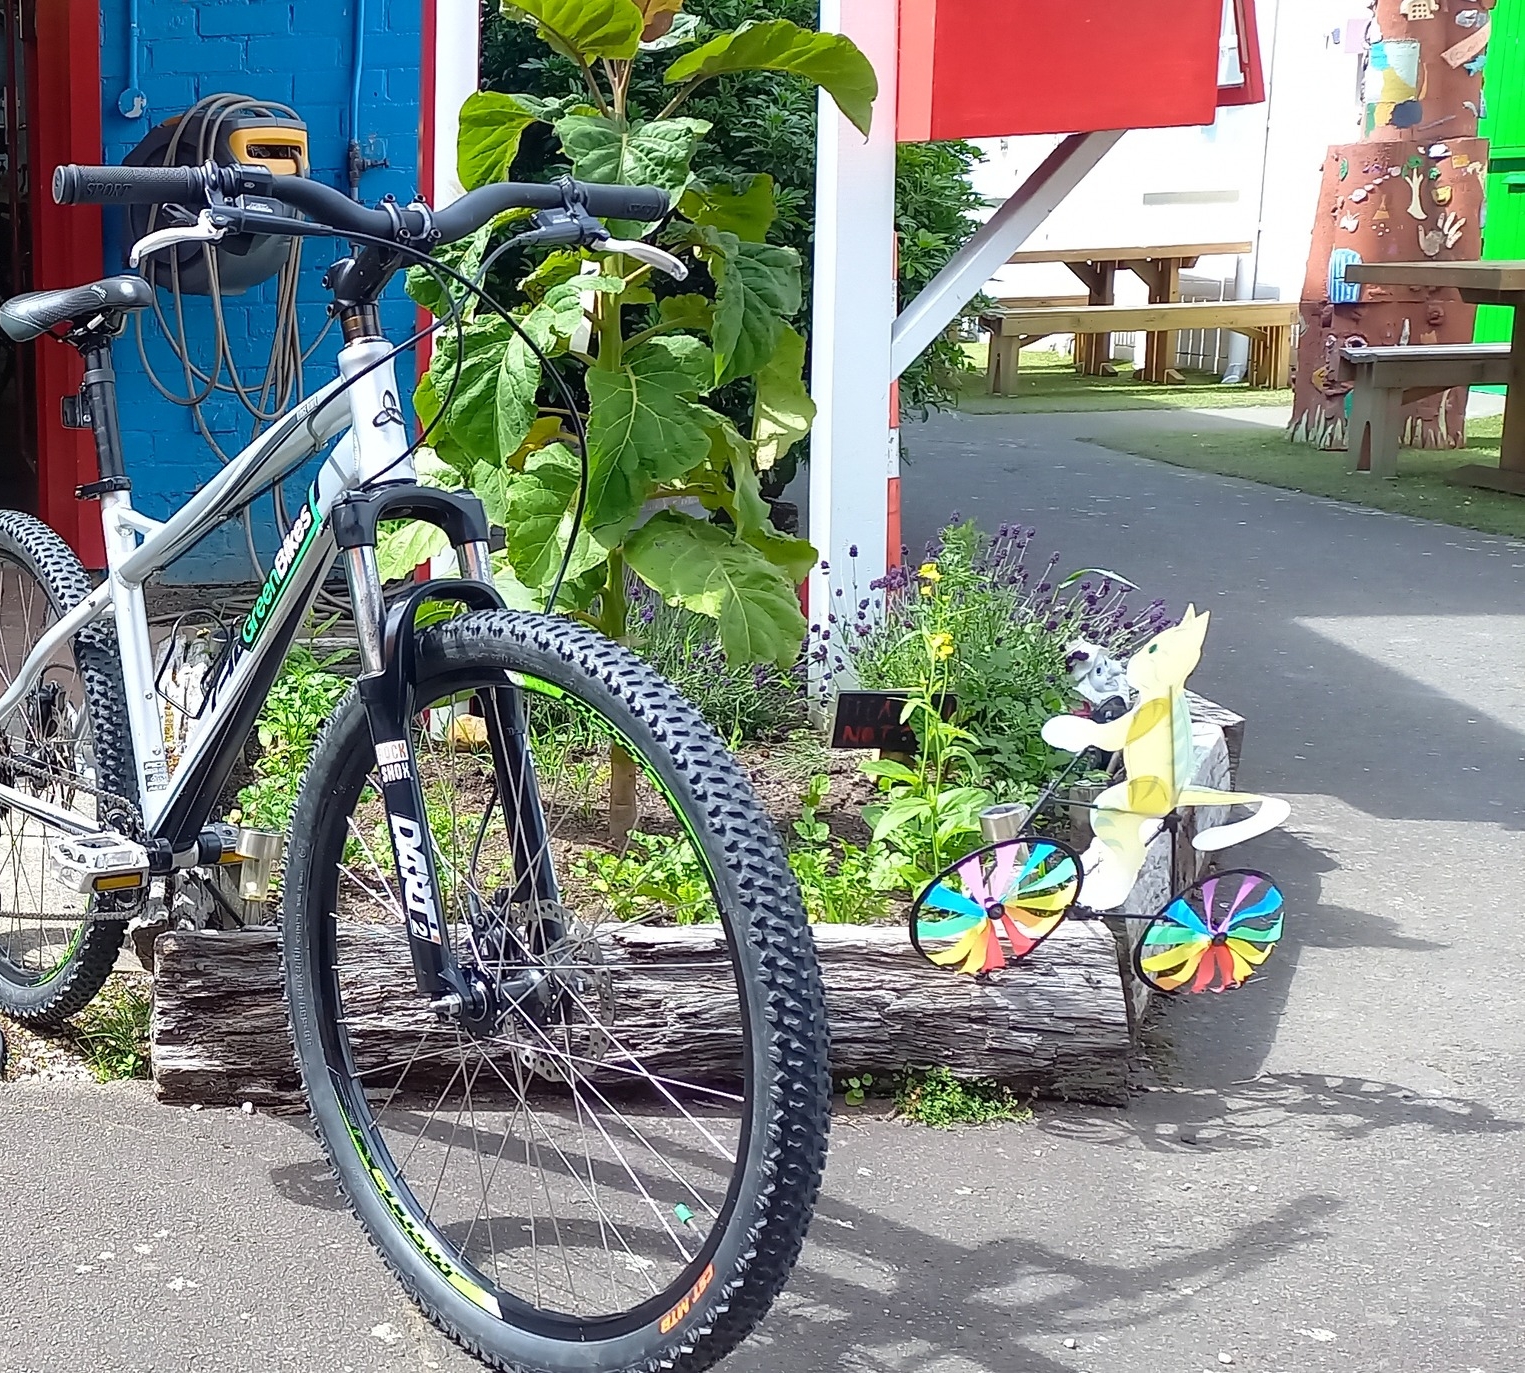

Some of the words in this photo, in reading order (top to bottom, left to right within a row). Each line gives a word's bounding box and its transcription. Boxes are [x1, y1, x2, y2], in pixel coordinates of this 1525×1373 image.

[86, 181, 133, 197] SPORT
[241, 503, 312, 644] GreenBikes
[380, 761, 412, 784] SHOX
[411, 920, 429, 938] 2
[691, 1263, 715, 1304] CST
[659, 1297, 690, 1334] MTB
